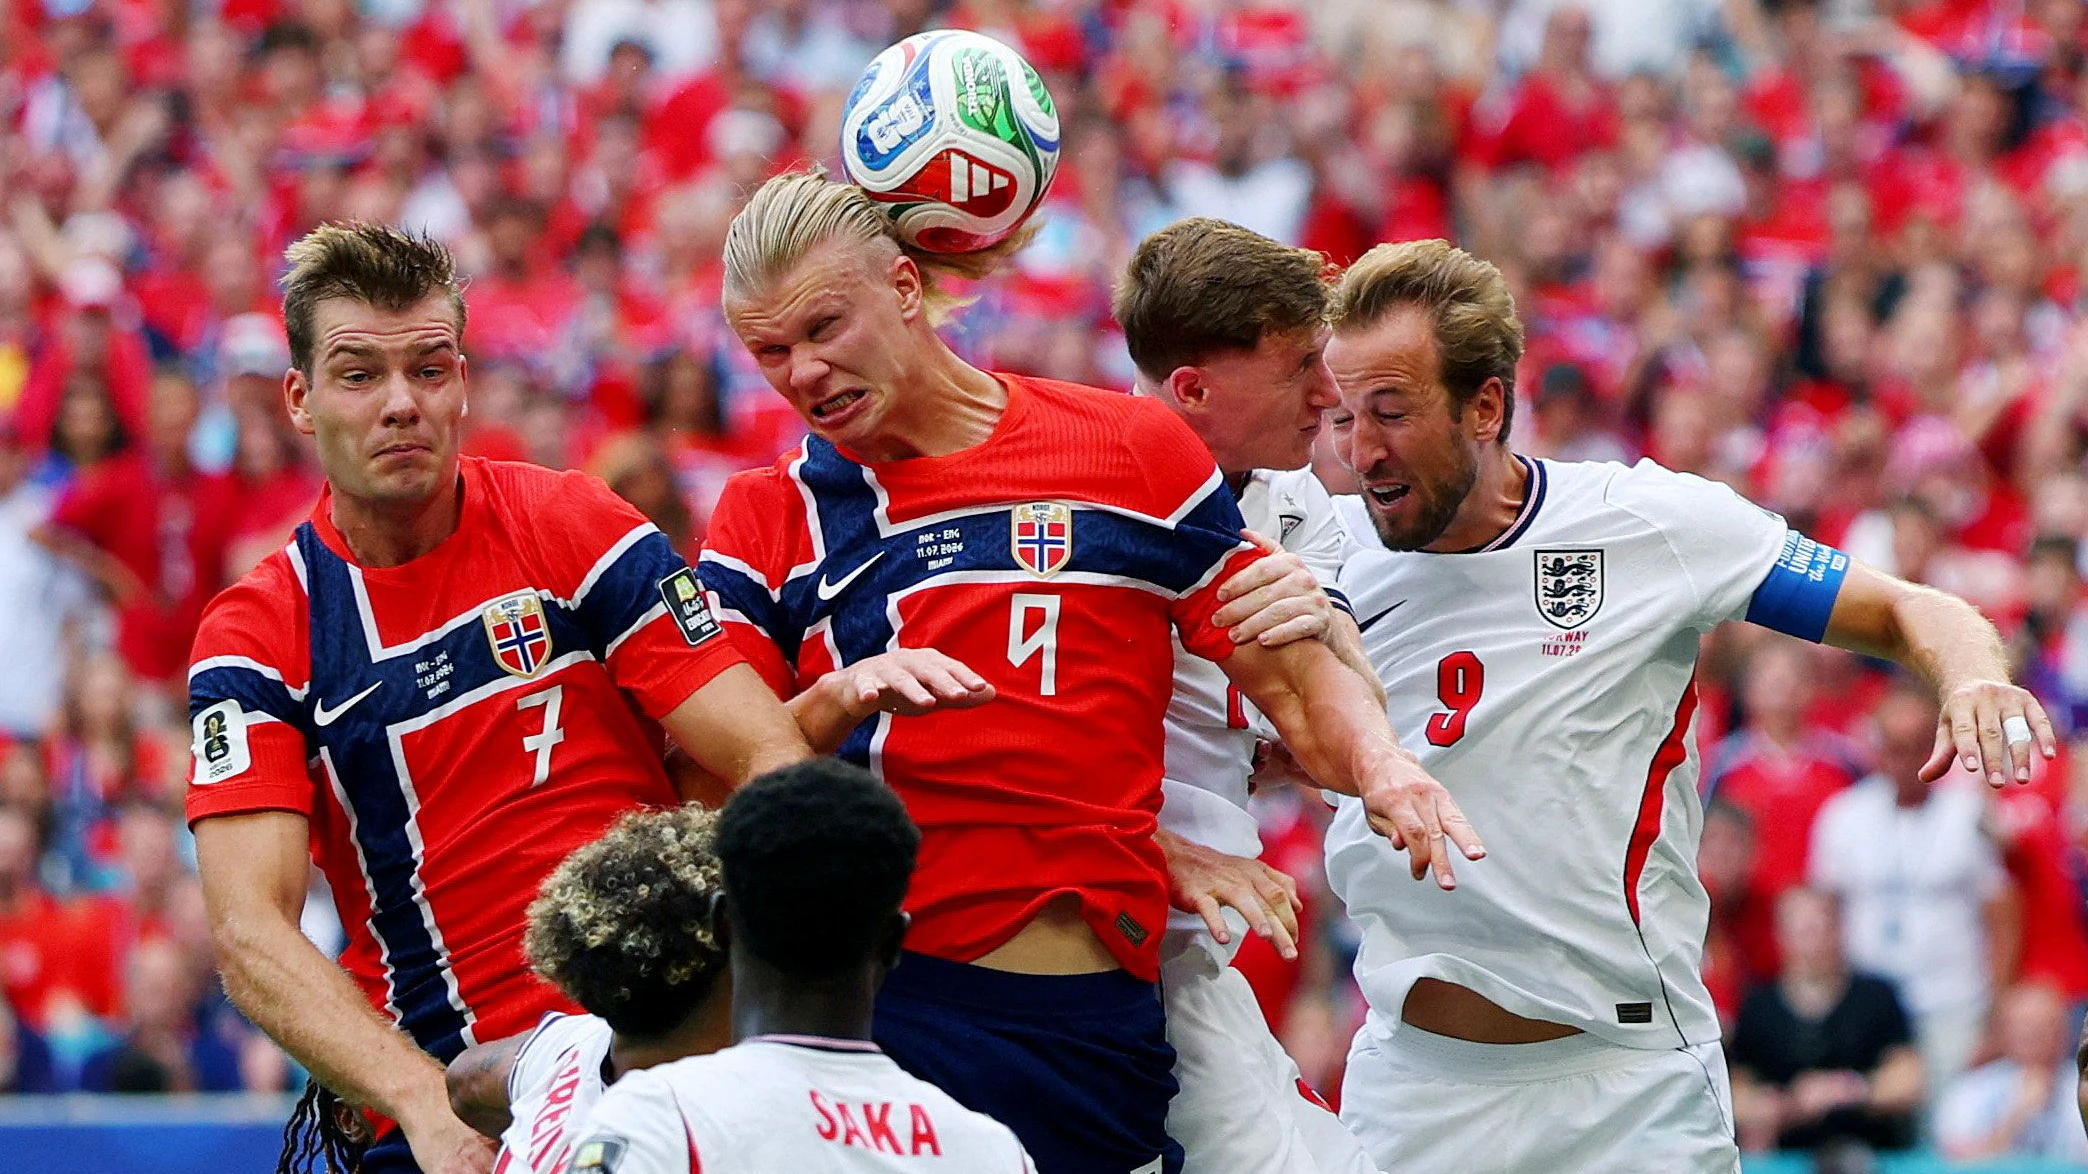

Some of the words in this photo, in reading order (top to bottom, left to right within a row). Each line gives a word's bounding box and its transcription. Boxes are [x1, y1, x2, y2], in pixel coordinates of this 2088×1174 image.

[1006, 593, 1061, 695] 9
[1545, 630, 1589, 642] RWAY
[517, 685, 564, 788] 7
[1425, 651, 1484, 747] 9
[809, 1090, 942, 1156] SAKA
